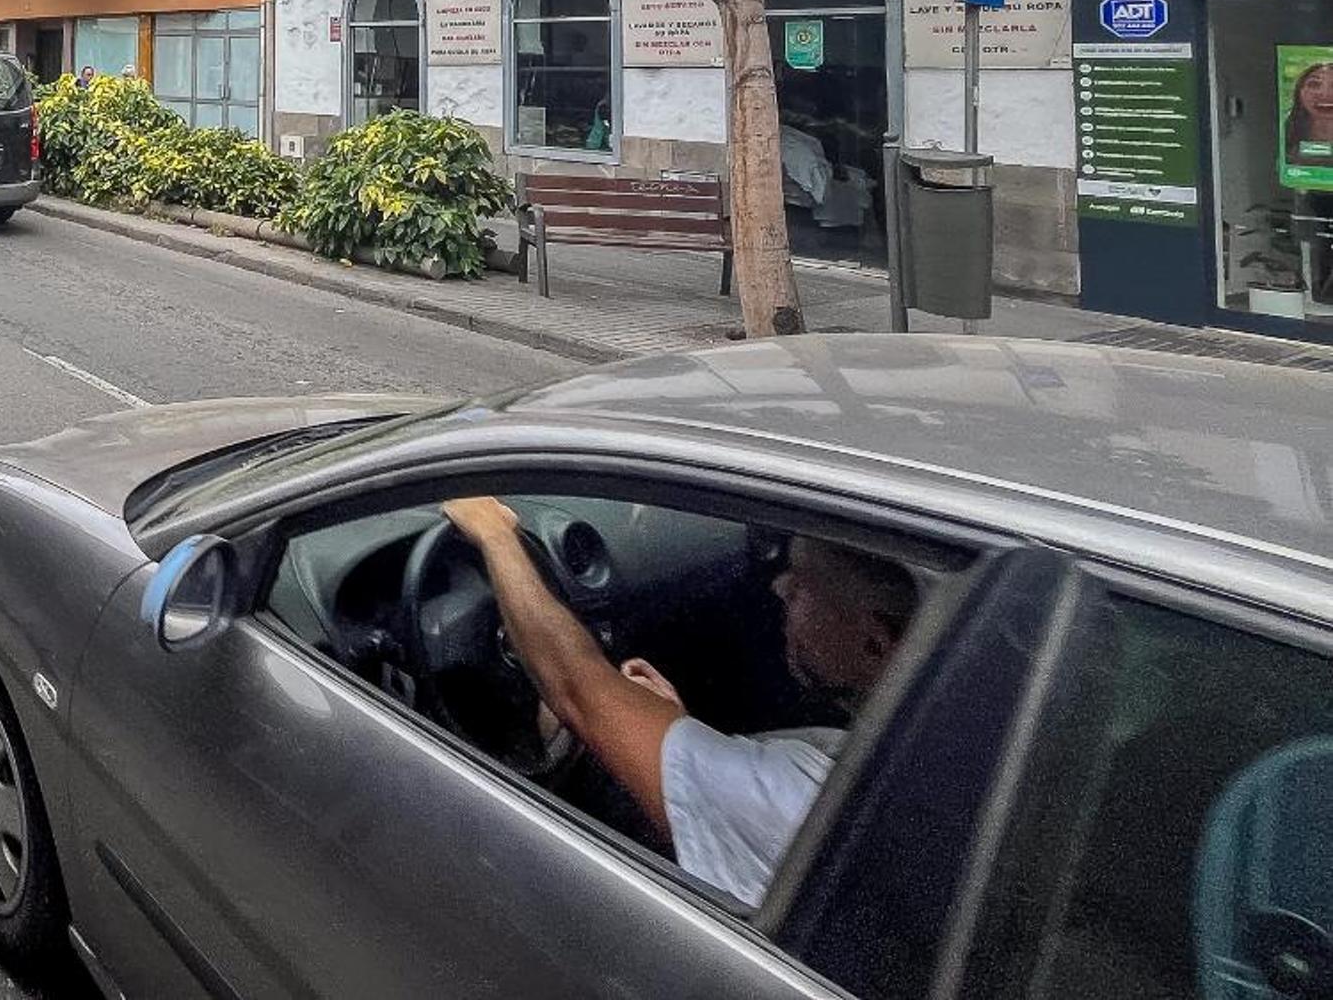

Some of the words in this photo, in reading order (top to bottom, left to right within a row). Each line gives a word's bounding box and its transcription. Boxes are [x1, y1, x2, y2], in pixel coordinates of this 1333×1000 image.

[1027, 2, 1063, 11] ROPA
[1114, 3, 1154, 20] ADT
[958, 24, 1037, 34] MZCLARLA
